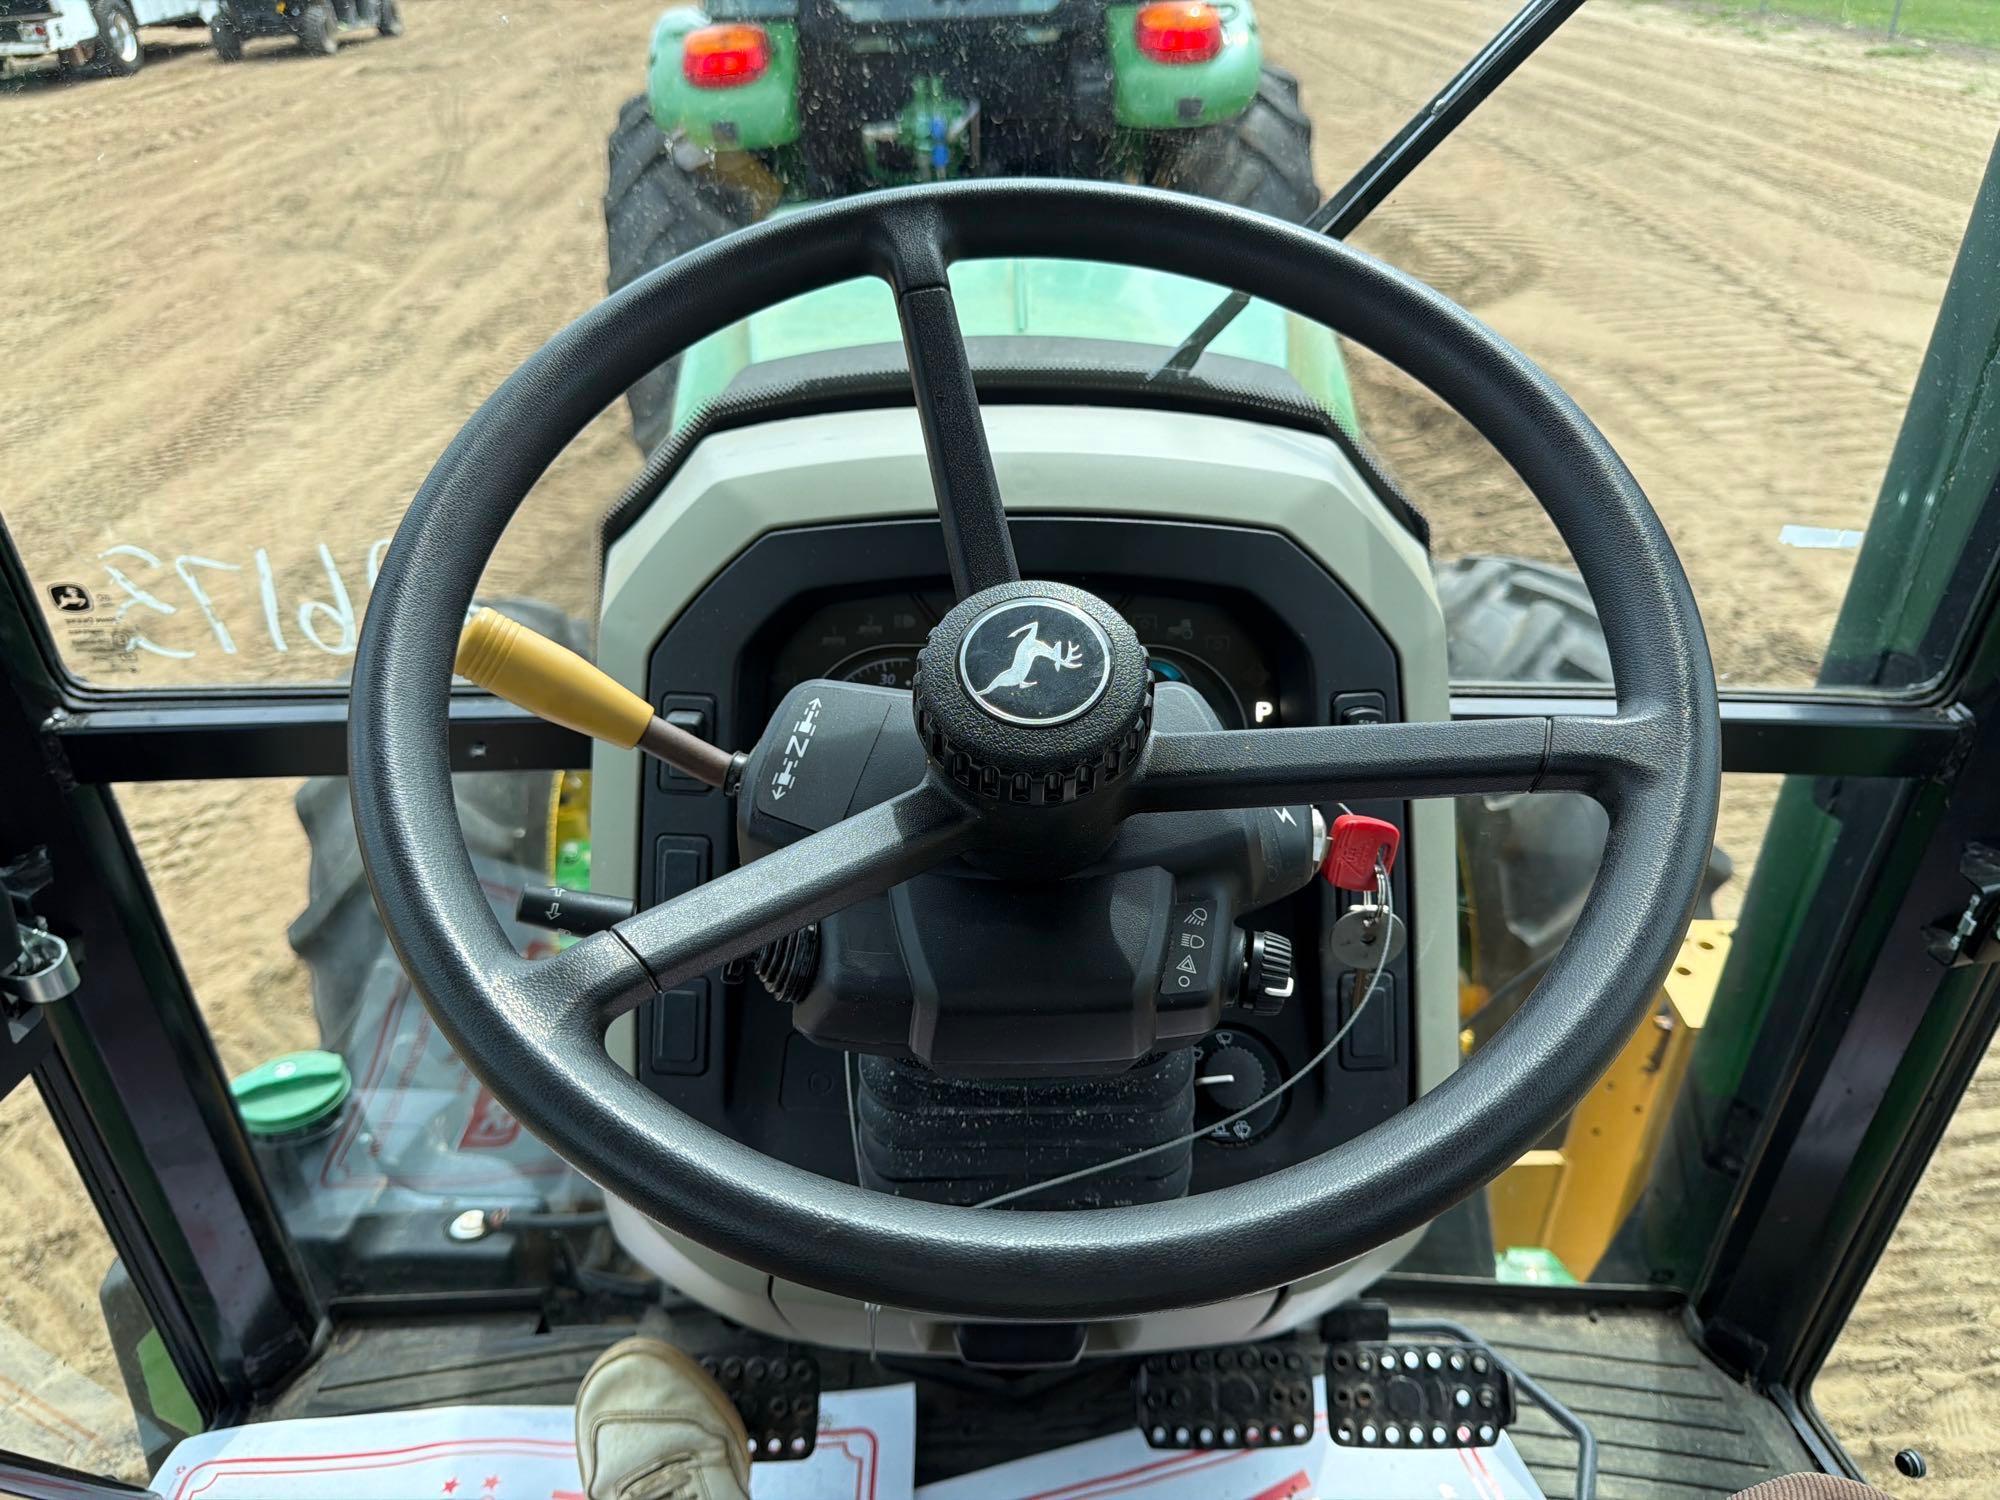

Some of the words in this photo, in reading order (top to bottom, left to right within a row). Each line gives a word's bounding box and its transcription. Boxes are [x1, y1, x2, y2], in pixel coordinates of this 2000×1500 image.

[879, 673, 896, 686] 30
[1255, 701, 1273, 723] P
[785, 735, 810, 758] N
